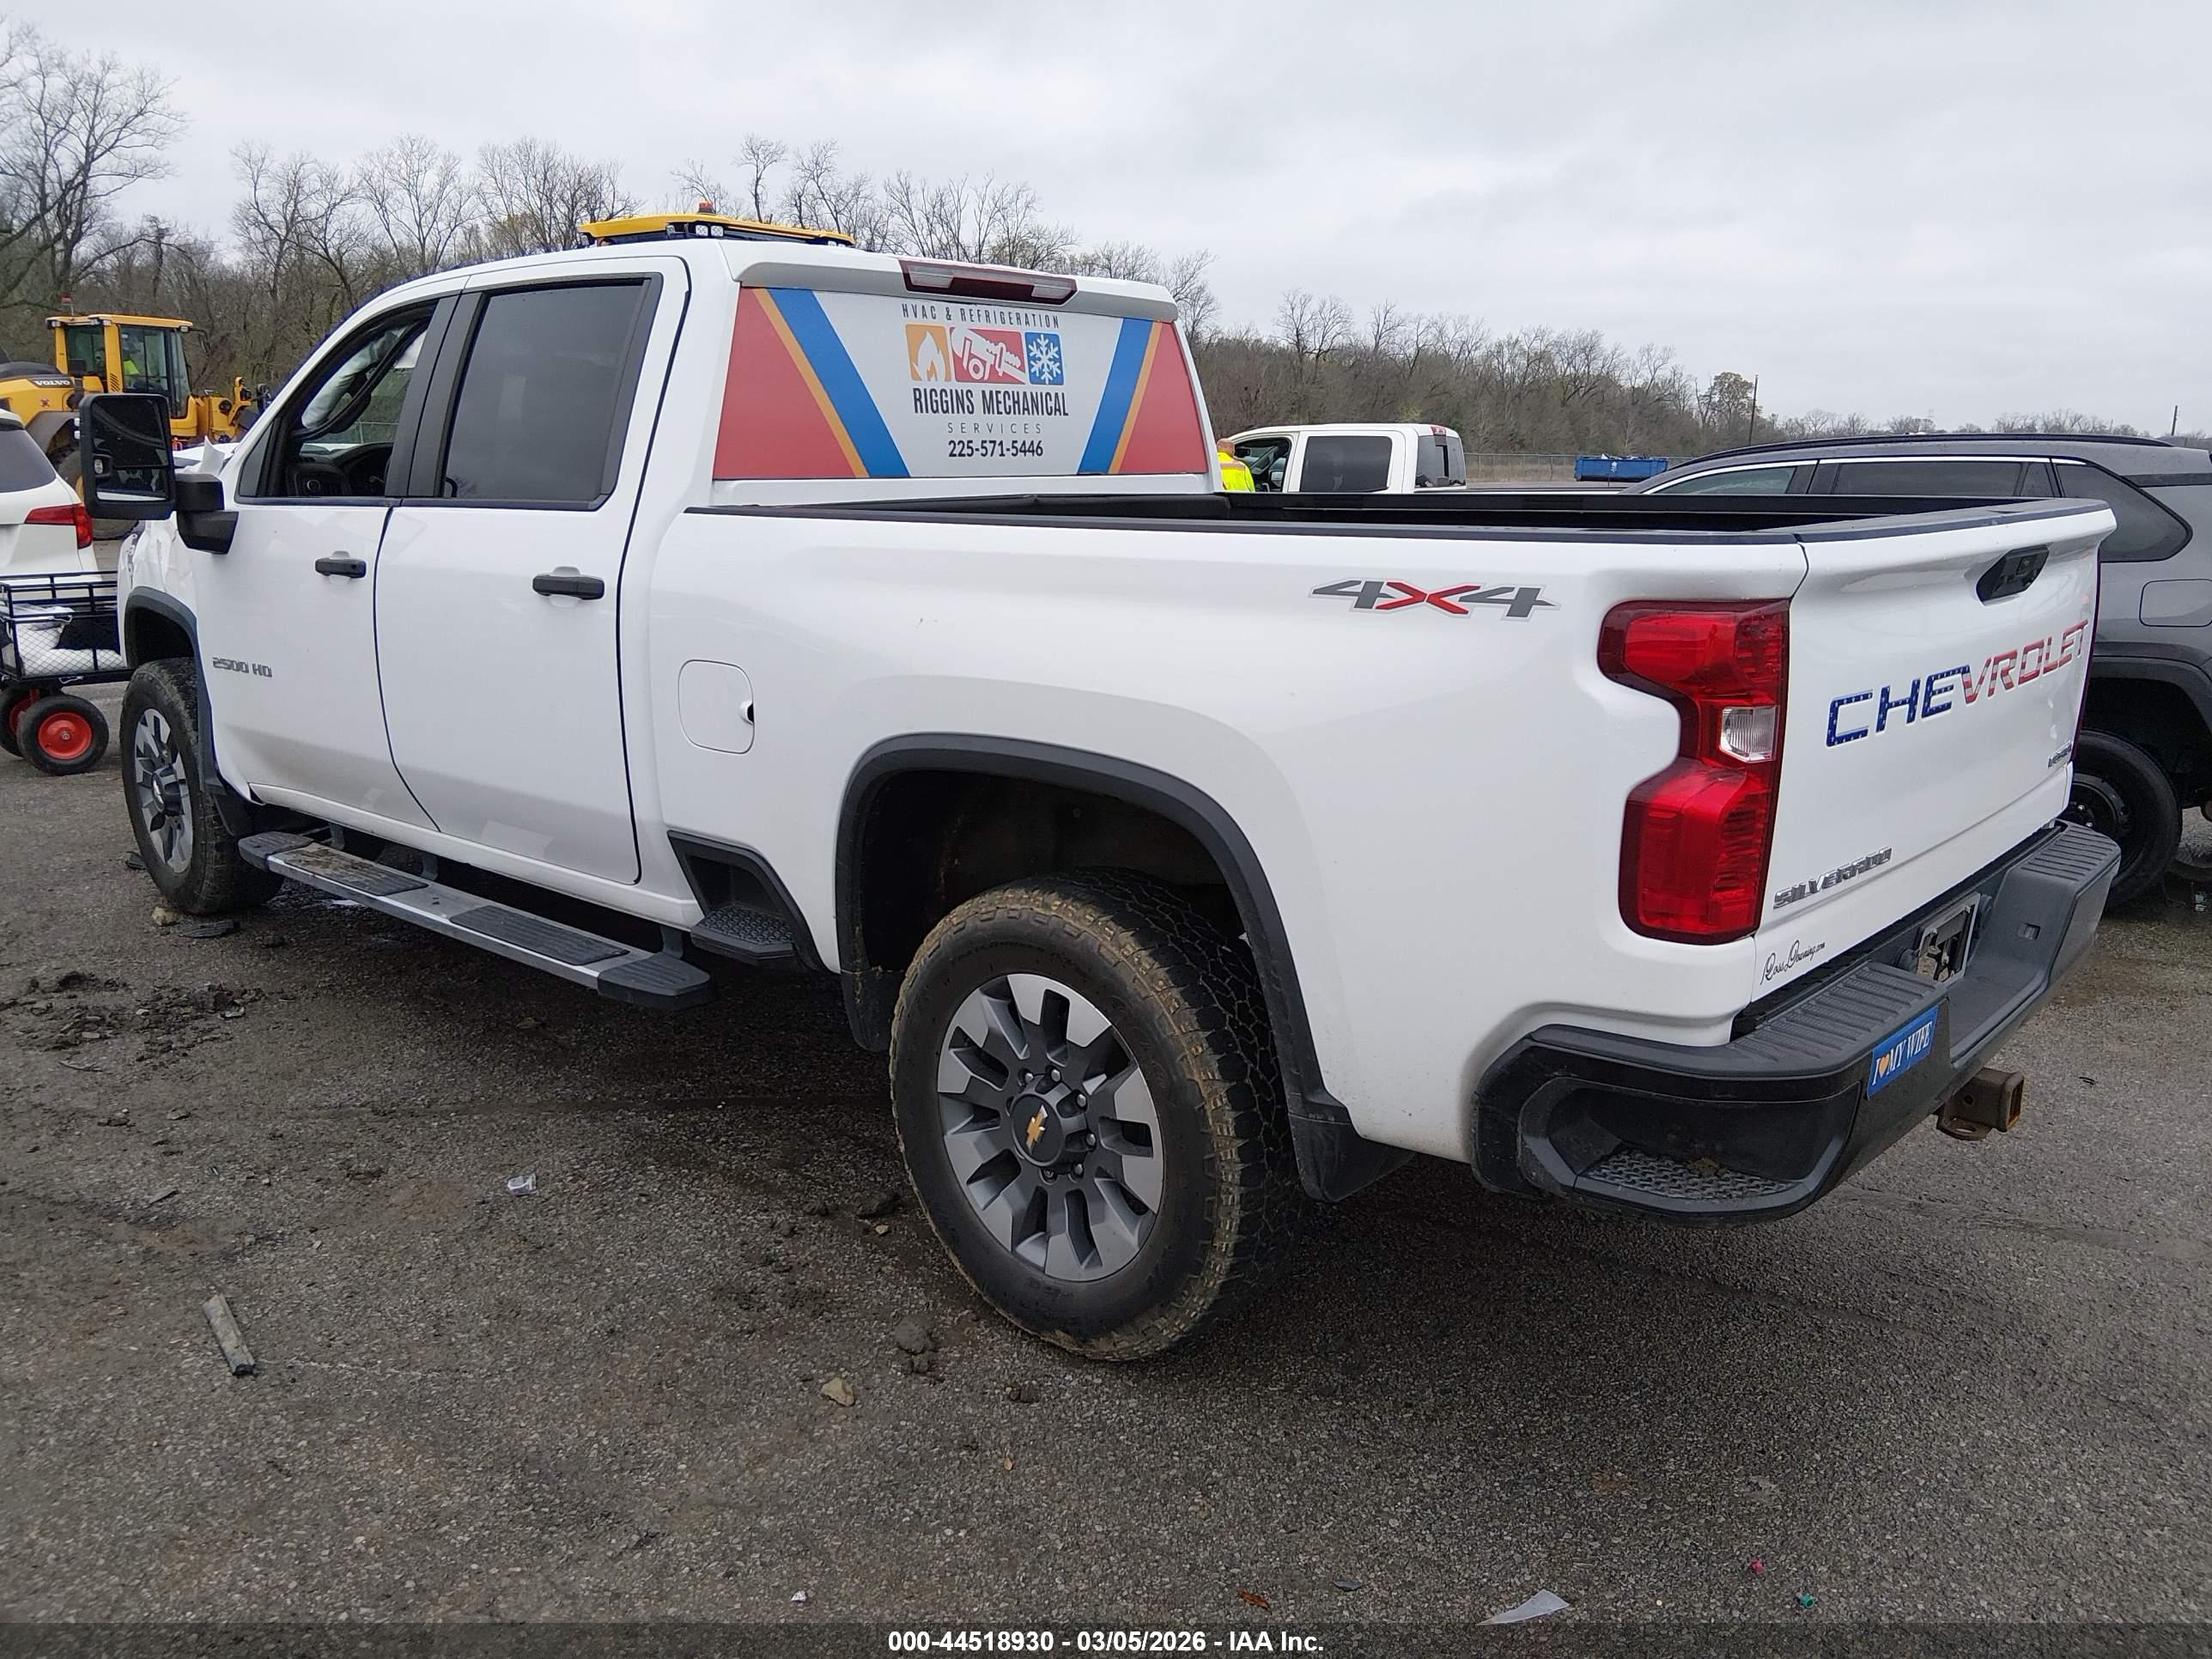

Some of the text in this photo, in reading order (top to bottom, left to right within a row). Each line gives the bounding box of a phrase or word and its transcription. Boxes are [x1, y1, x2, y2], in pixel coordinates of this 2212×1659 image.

[902, 304, 1060, 329] HVAC & REFRIGERATION
[913, 387, 1069, 416] RIGGINS MECHANICAL
[947, 422, 1042, 434] SERVICES
[948, 440, 1044, 458] 225-571-5446
[212, 657, 273, 678] 2500 HD
[1826, 619, 2089, 748] CHEVROLET
[1773, 846, 1893, 910] SILVERADO
[1872, 1021, 1933, 1086] I MY WIFE
